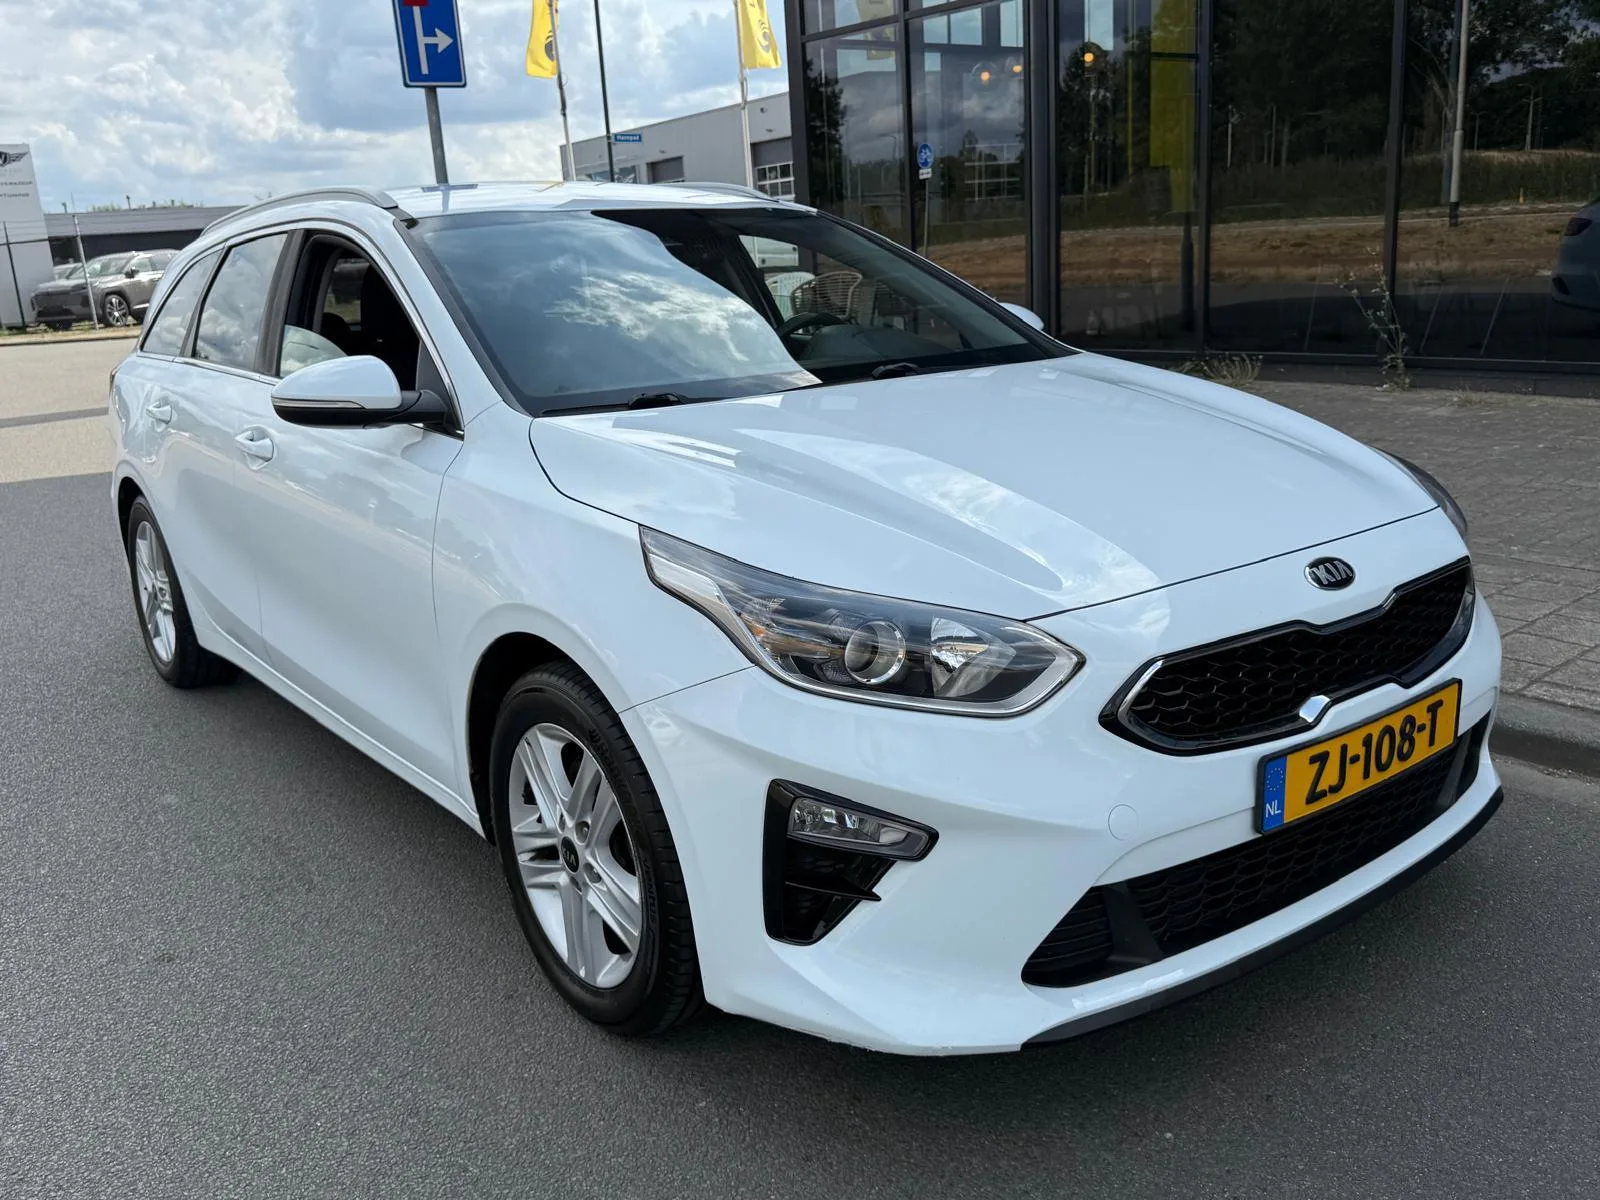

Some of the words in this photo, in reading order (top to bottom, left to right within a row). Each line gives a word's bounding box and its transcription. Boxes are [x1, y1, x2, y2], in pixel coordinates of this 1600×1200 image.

[1309, 560, 1353, 585] KIA
[1305, 699, 1444, 805] ZJ-108-T
[1265, 799, 1282, 818] NL
[562, 847, 577, 866] KIA
